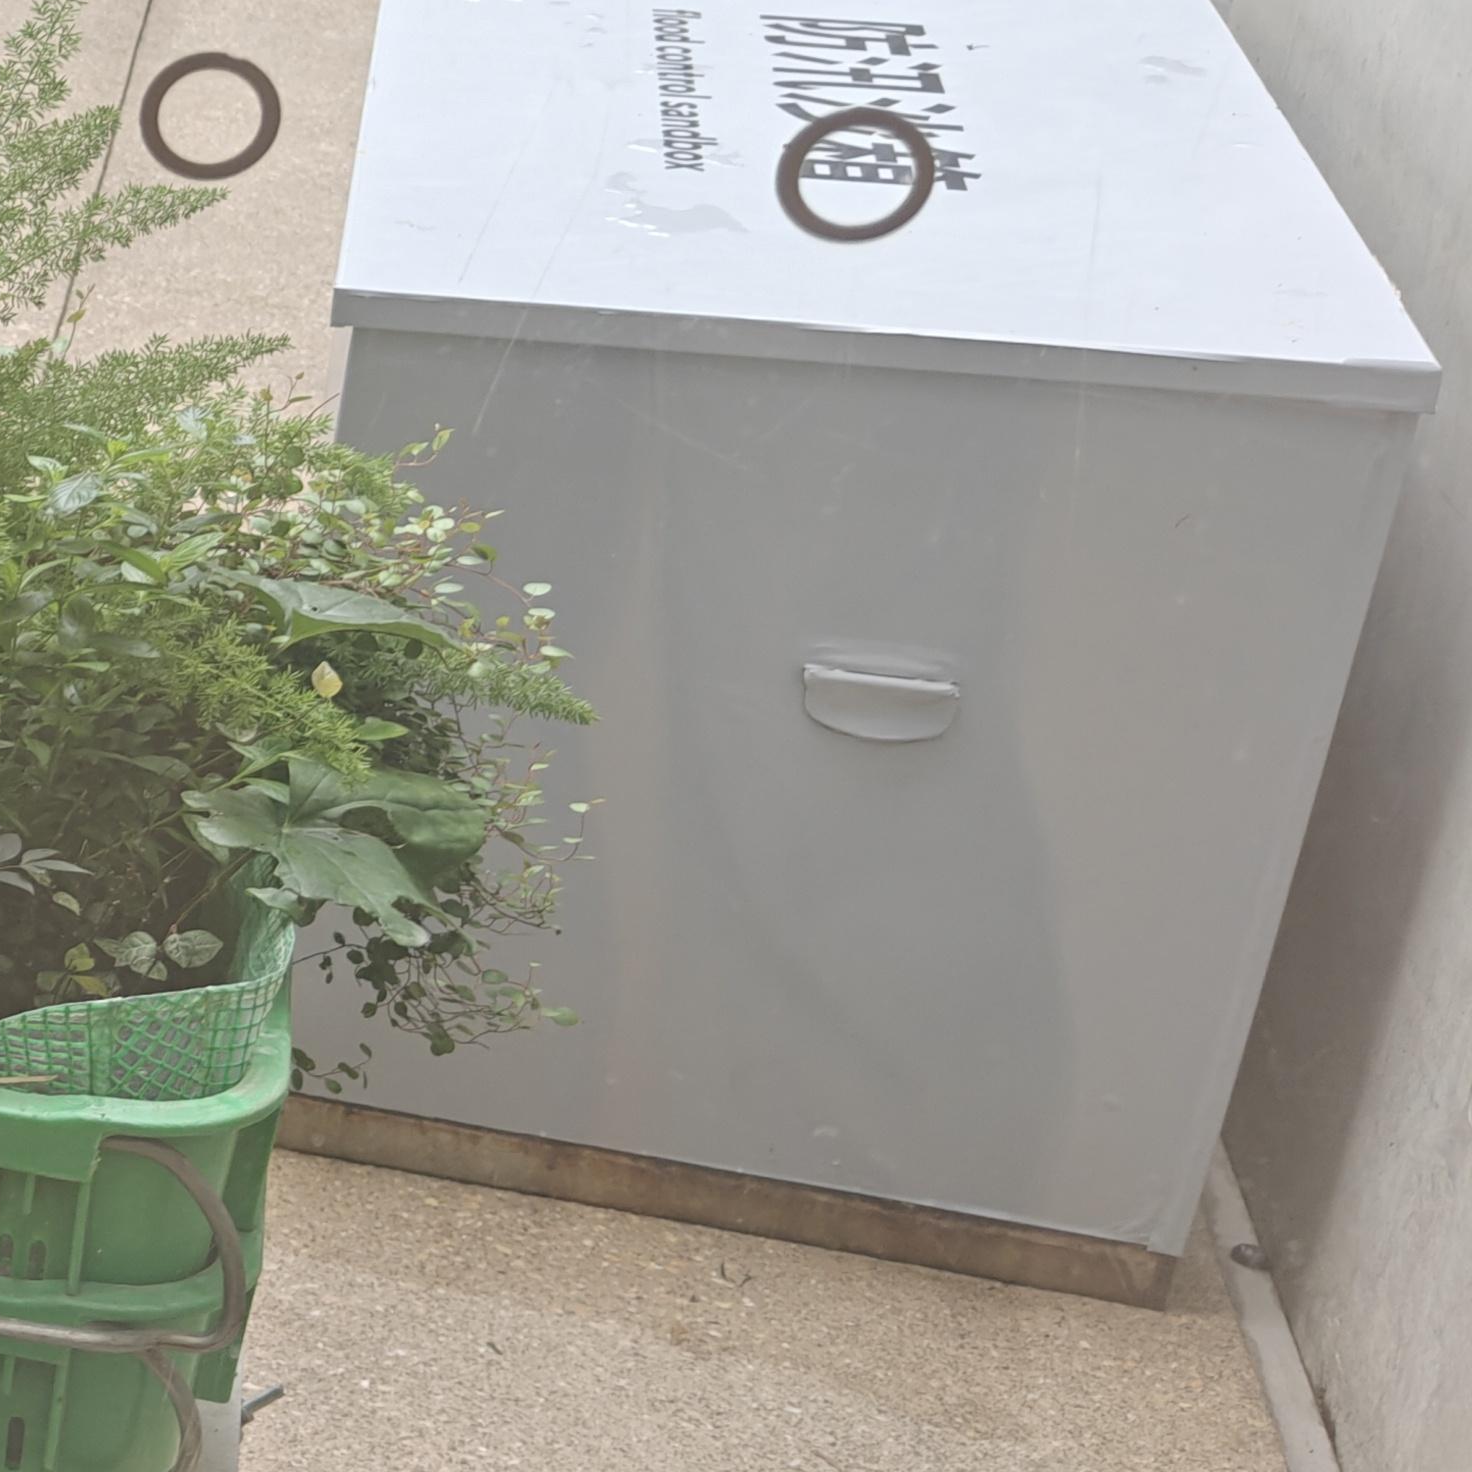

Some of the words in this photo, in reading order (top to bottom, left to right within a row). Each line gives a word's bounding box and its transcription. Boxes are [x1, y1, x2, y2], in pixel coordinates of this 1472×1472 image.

[652, 8, 705, 44] flood
[656, 45, 712, 99] control
[660, 100, 718, 172] sandbox
